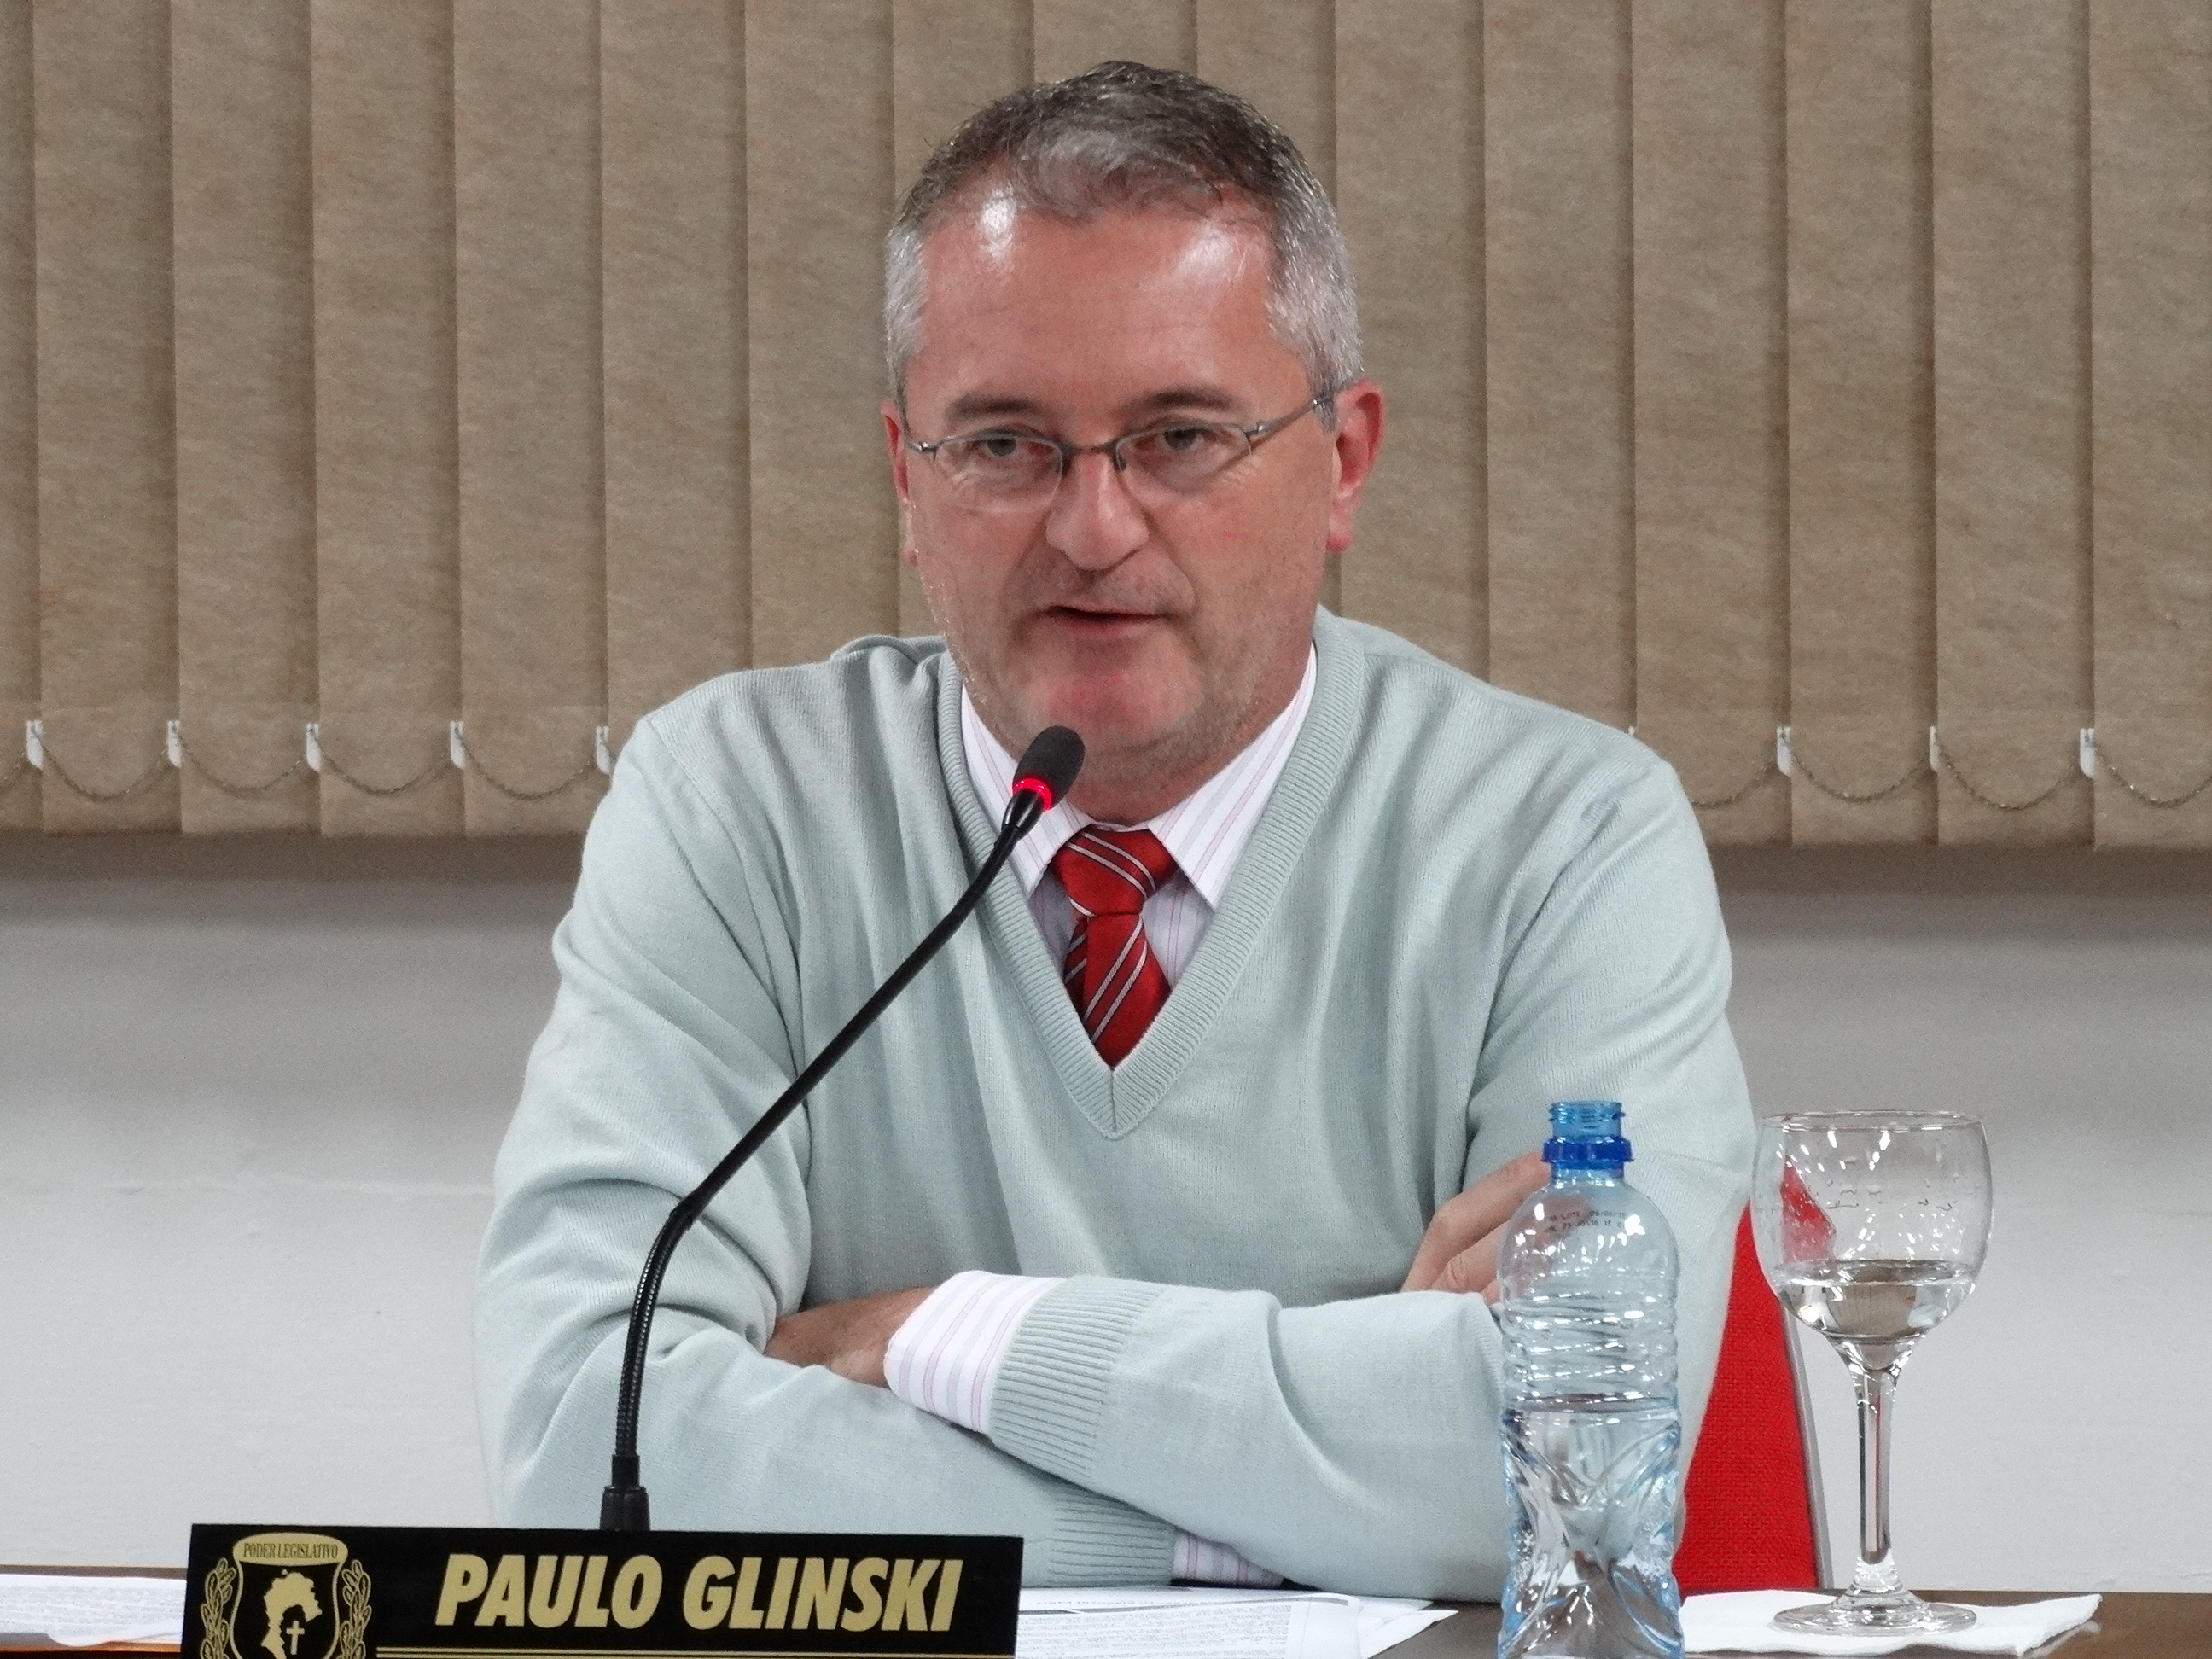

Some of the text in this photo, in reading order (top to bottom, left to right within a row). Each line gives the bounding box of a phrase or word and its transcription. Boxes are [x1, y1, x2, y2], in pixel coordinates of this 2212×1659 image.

[243, 1542, 339, 1559] PODER LEGISLATIVO
[435, 1554, 663, 1629] PAULO
[684, 1555, 963, 1632] GLINSKI
